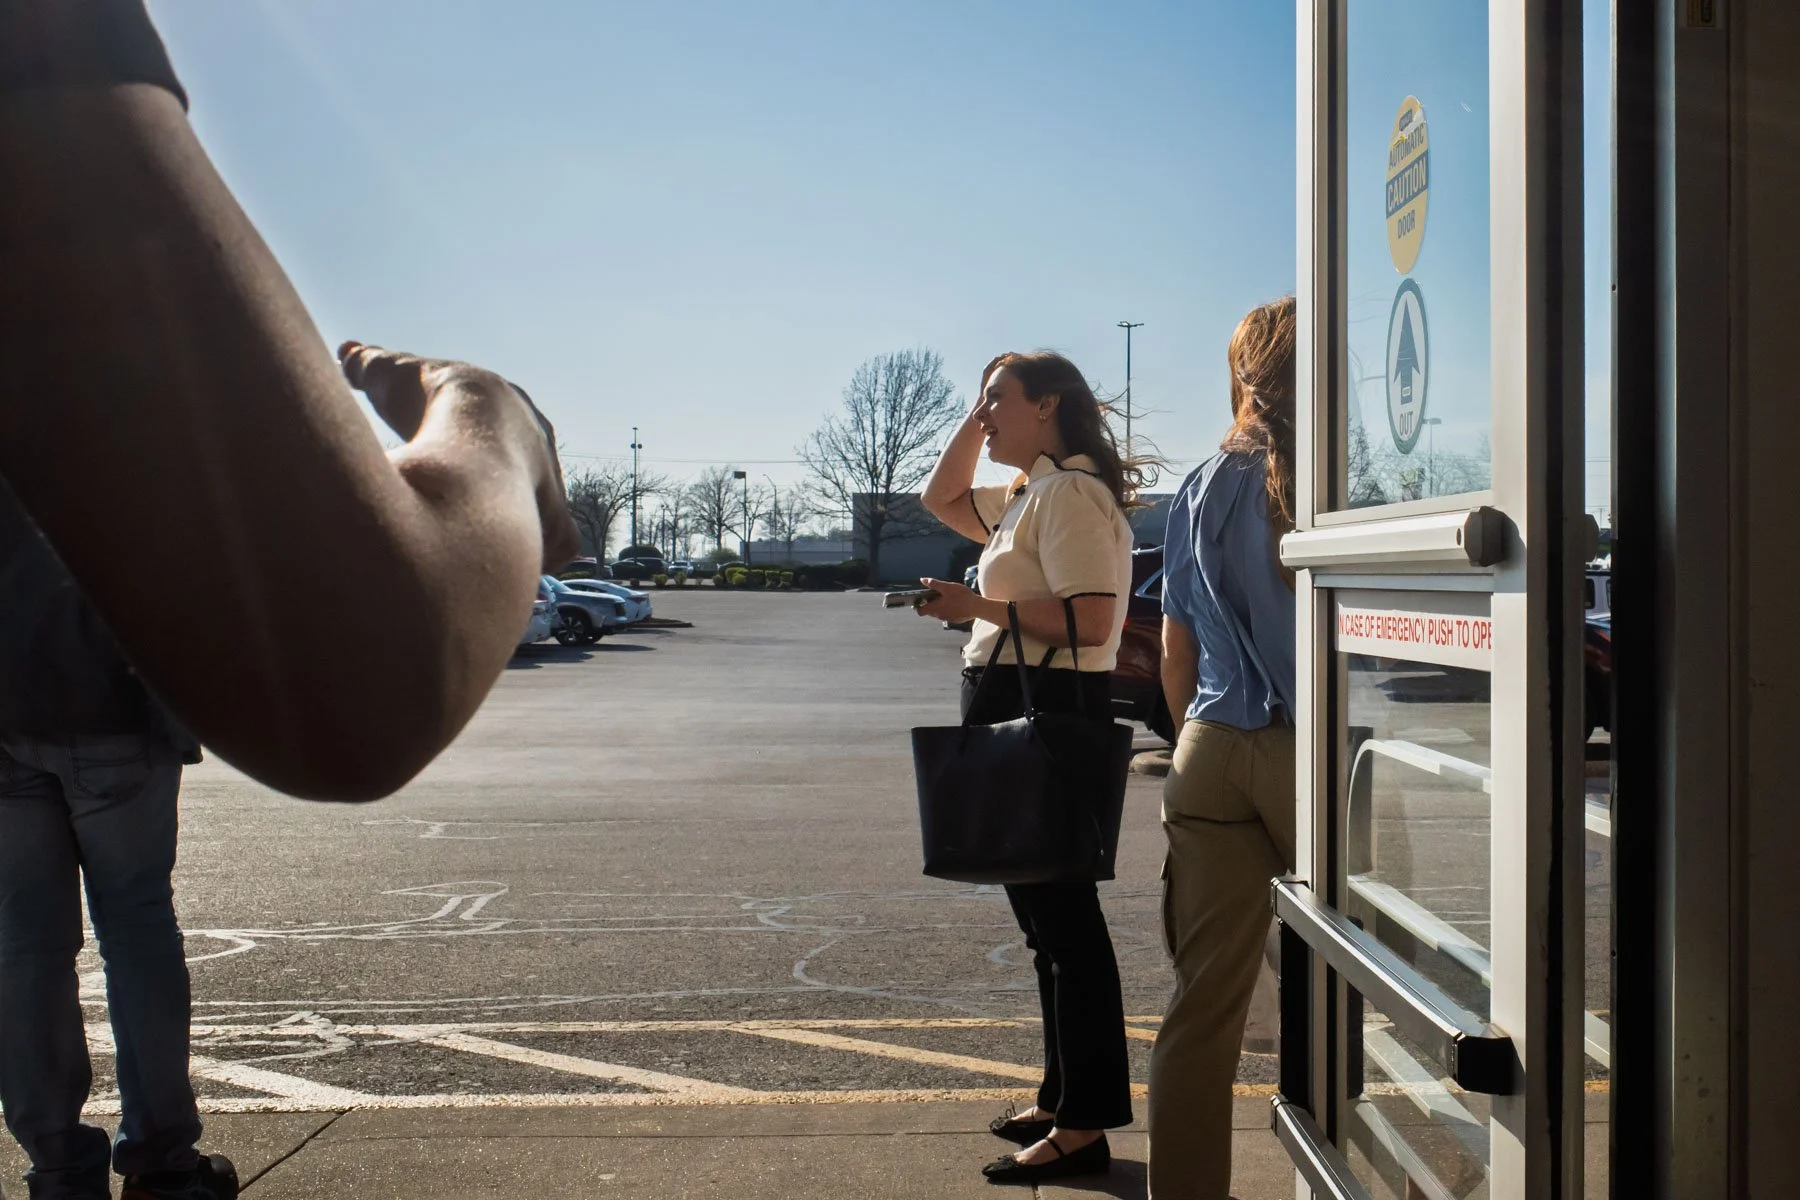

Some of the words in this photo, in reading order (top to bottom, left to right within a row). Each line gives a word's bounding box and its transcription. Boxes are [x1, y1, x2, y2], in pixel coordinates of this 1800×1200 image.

[1389, 122, 1424, 172] AUTOMATIC
[1387, 156, 1426, 212] CAUTION
[1398, 209, 1416, 239] DOOR
[1399, 410, 1414, 436] OUT
[1345, 614, 1363, 637] CASE
[1365, 615, 1375, 638] OF
[1376, 616, 1425, 643] EMERGENCY
[1428, 618, 1454, 646] PUSH
[1456, 620, 1470, 648] TO
